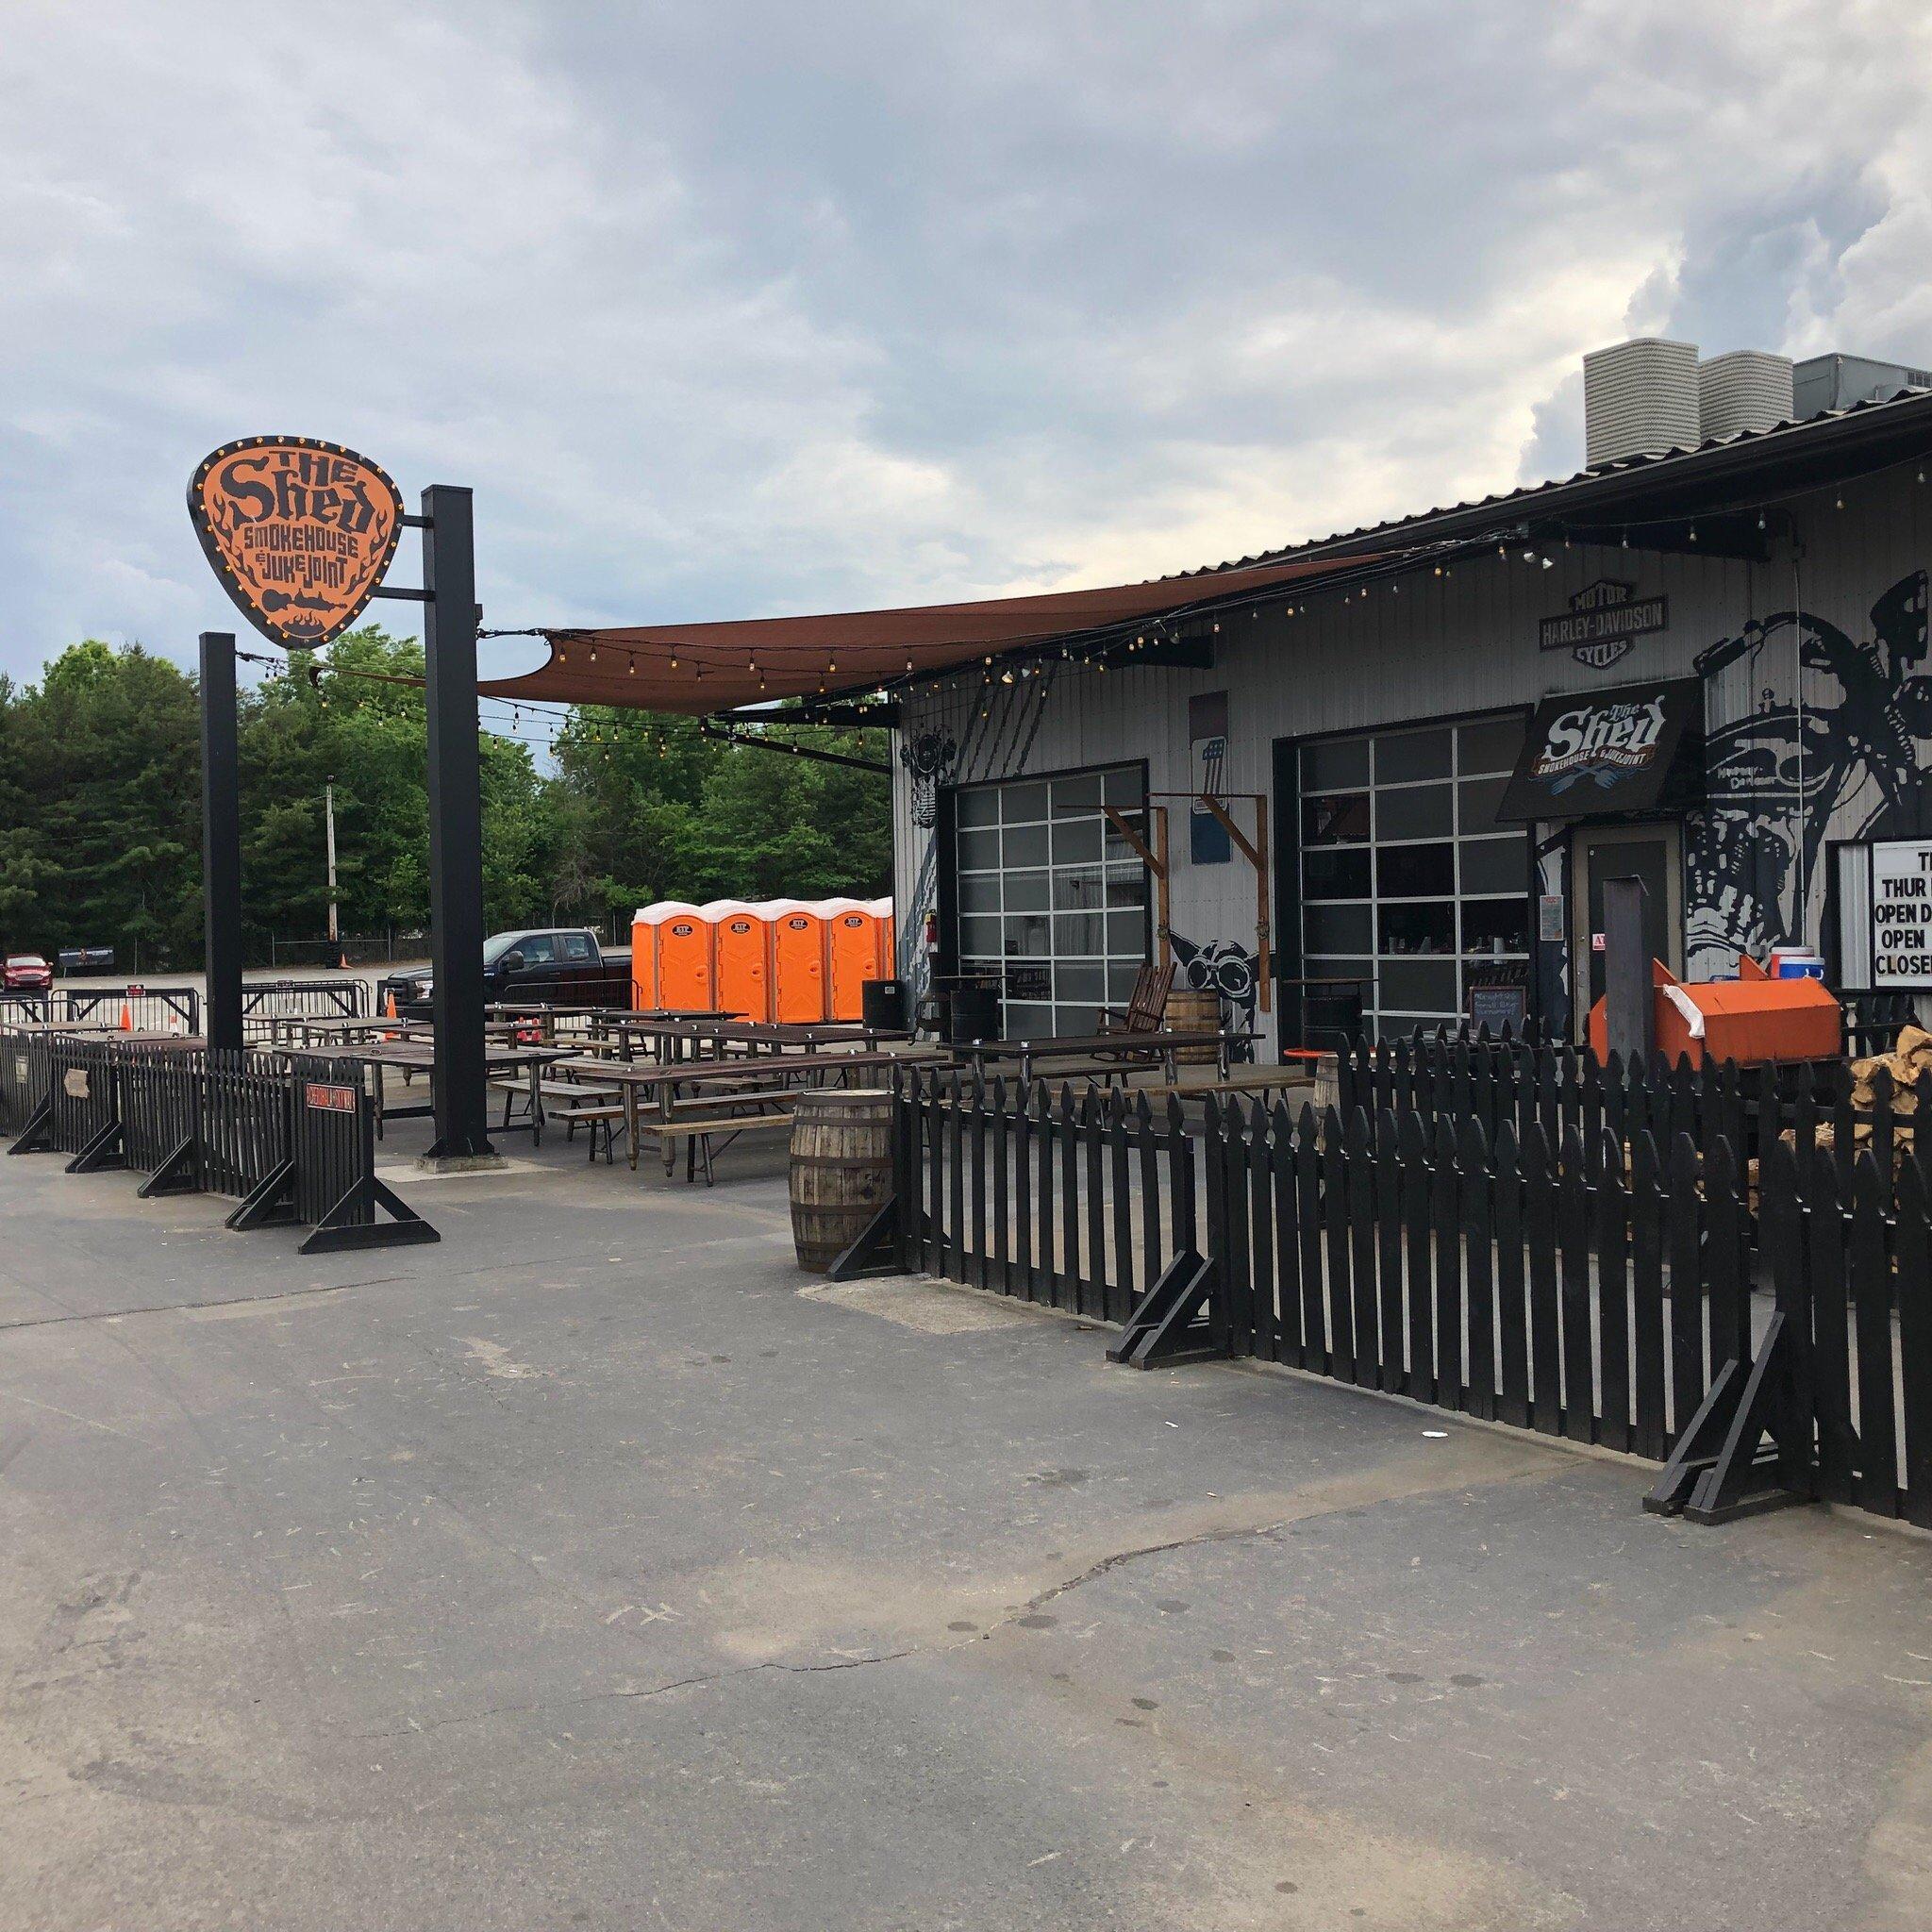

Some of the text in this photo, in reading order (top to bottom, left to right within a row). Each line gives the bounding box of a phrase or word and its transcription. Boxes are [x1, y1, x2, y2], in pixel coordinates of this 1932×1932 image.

[269, 451, 358, 487] THE
[244, 524, 358, 558] SMOKEHOUSE
[262, 553, 306, 584] JUKE
[303, 554, 347, 589] JOINT
[1575, 583, 1627, 611] MOTOR
[1543, 603, 1662, 646] HARLEY-DAVIDSON
[1576, 639, 1627, 666] CYCLES
[1610, 703, 1641, 721] The
[1538, 750, 1591, 774] SMOKEHOUSE
[1918, 852, 1932, 872] T
[1882, 877, 1926, 898] THUR
[1874, 904, 1917, 924] OPEN
[1881, 929, 1925, 949] OPEN
[1875, 955, 1932, 975] CLOSE
